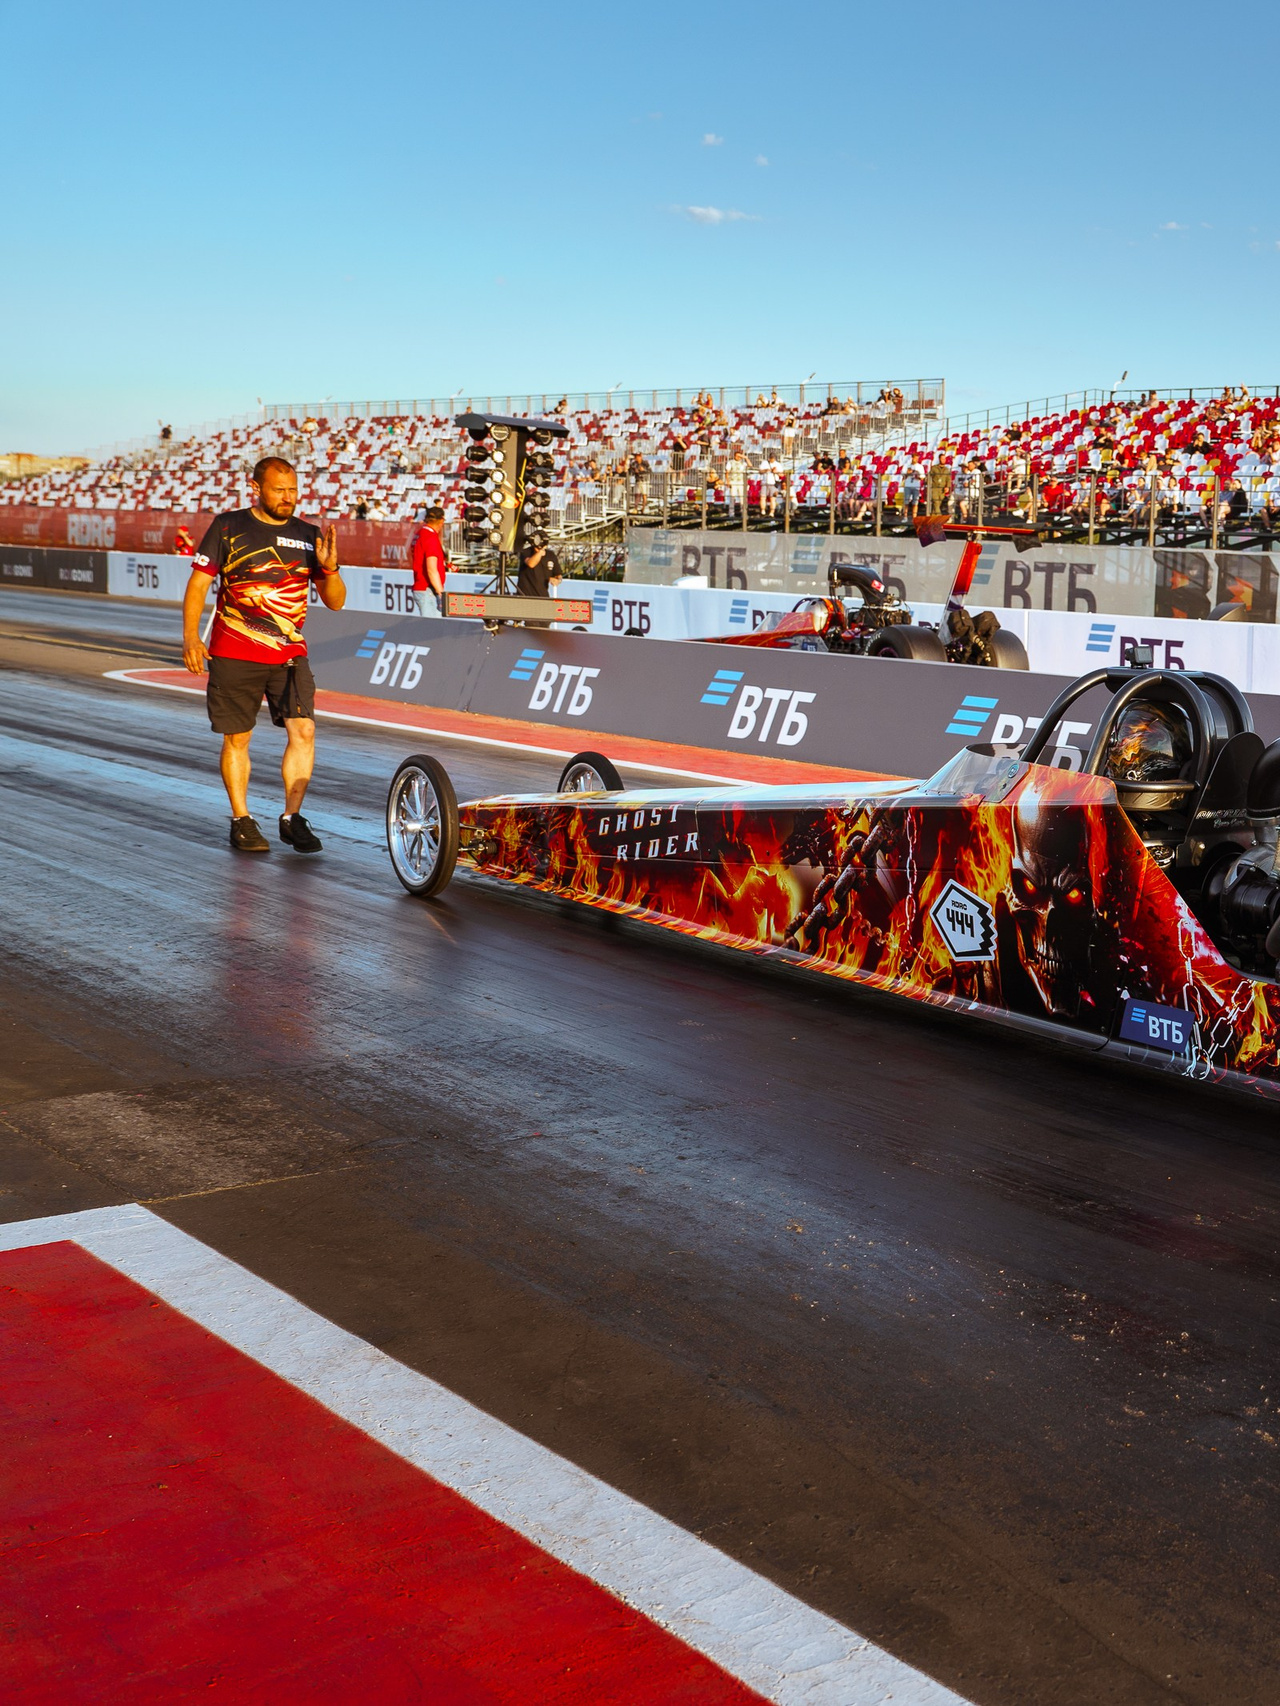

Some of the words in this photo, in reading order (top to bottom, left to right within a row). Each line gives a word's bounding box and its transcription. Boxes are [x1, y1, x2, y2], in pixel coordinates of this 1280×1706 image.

[67, 514, 116, 548] RDRC
[276, 536, 314, 551] RDRC
[381, 544, 409, 560] LYNX
[682, 545, 748, 590] ВТБ
[137, 565, 159, 588] ВТБ
[1003, 560, 1097, 613] ВТБ
[385, 583, 415, 613] ВТБ
[612, 599, 651, 634] ВТБ
[369, 642, 430, 690] ВТБ
[528, 662, 600, 716] ВТБ
[727, 685, 817, 746] ВТБ
[598, 803, 684, 836] GHOST
[616, 832, 698, 862] RIDER
[946, 908, 975, 938] 444
[1148, 1015, 1183, 1044] ВТБ
